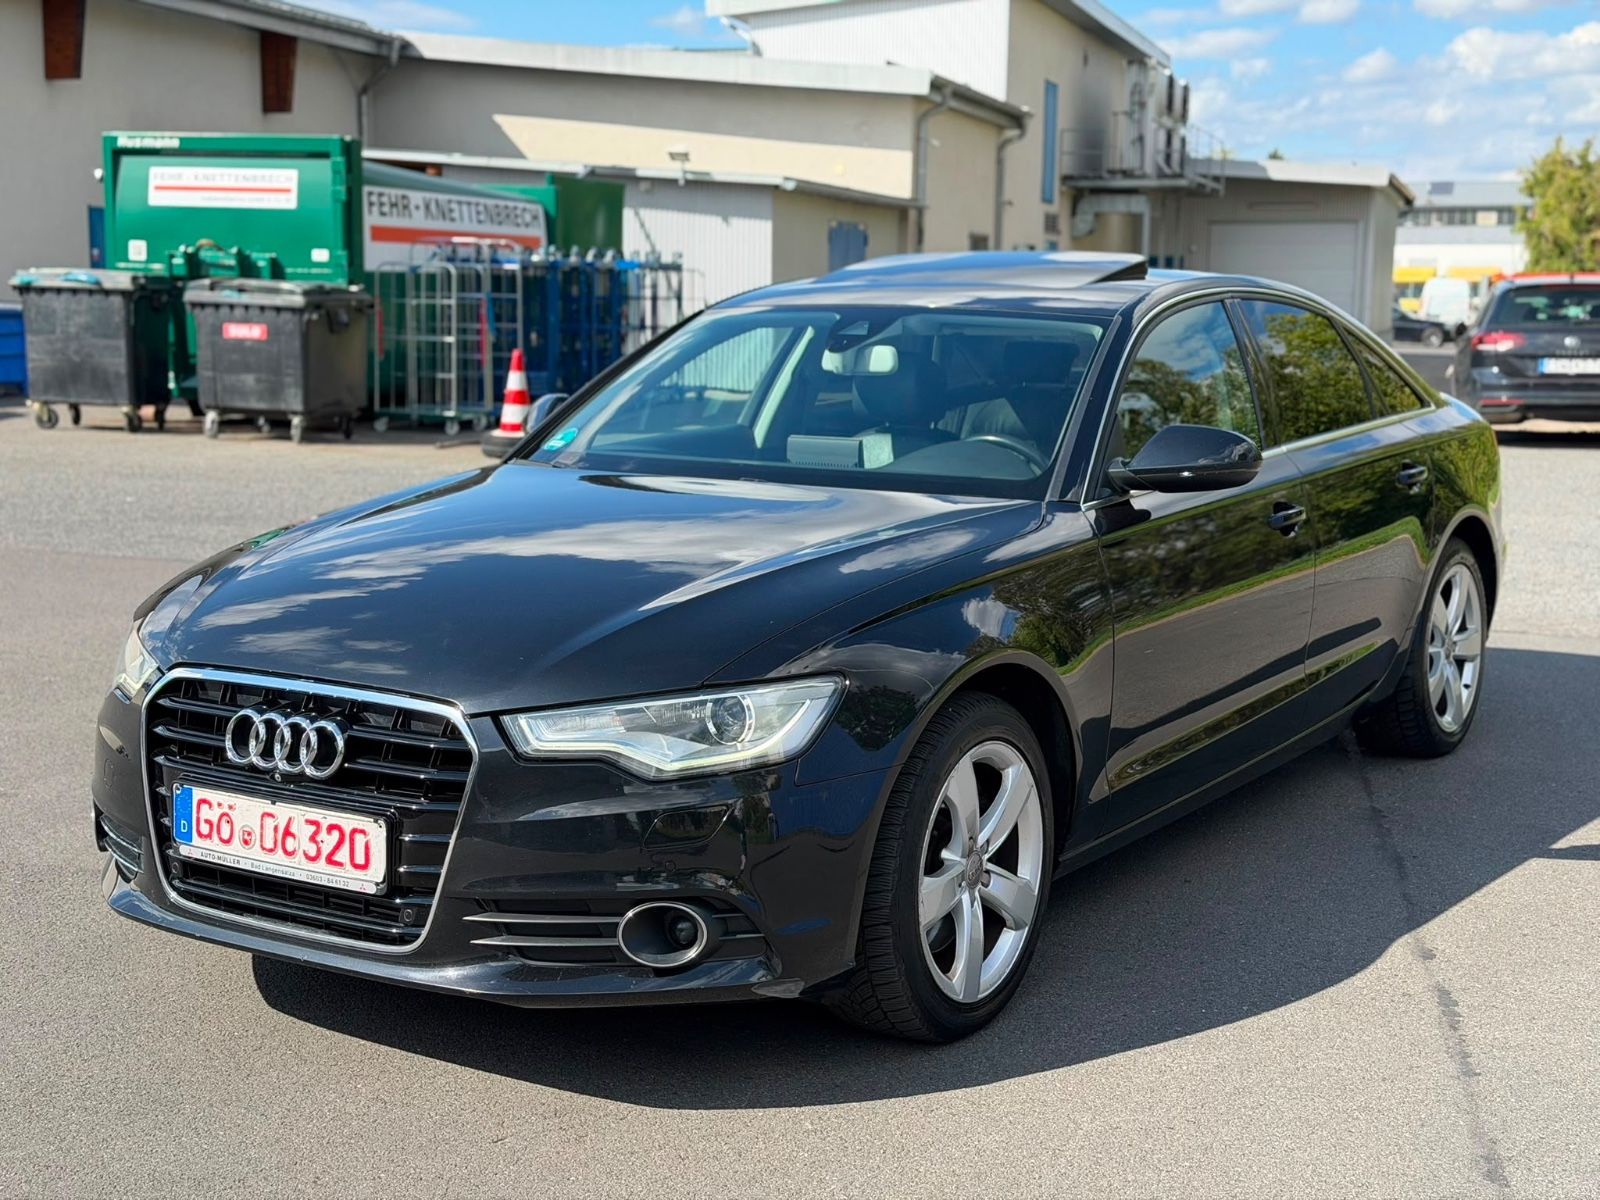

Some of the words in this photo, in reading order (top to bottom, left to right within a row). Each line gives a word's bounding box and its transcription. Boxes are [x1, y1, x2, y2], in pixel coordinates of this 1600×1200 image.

[366, 191, 413, 220] FEHR
[424, 197, 541, 229] KNETTENBRECH
[180, 820, 188, 833] D
[195, 798, 236, 847] GÖ
[259, 811, 371, 872] 06320
[250, 861, 262, 870] Bad
[262, 864, 296, 877] Langensalza
